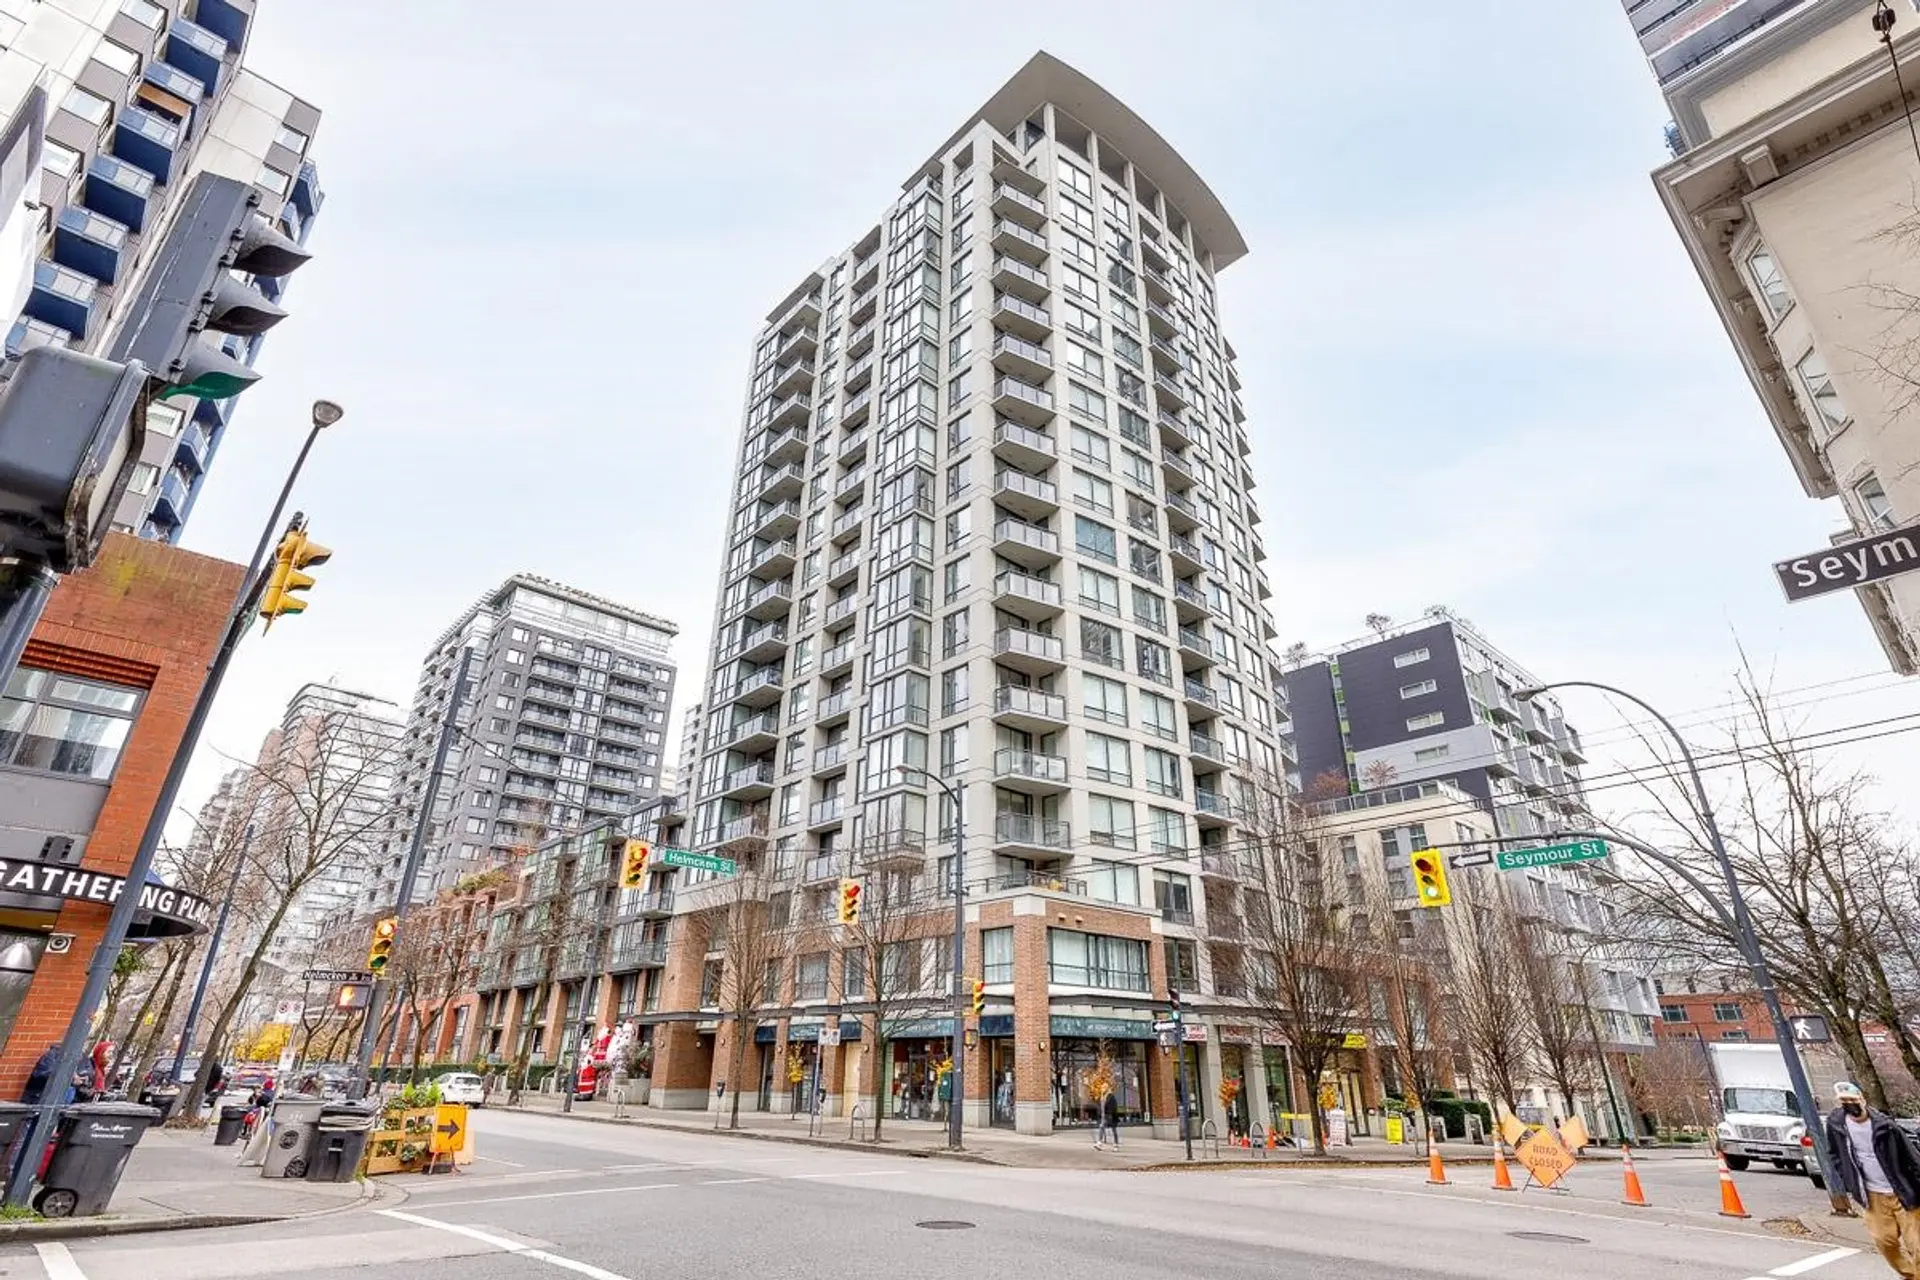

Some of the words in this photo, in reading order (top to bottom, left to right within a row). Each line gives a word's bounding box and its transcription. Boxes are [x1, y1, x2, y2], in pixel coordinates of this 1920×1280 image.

[668, 852, 718, 870] Helmcken
[720, 860, 732, 873] St
[1503, 847, 1575, 866] Seymour
[1579, 843, 1600, 856] St
[0, 861, 175, 914] ATHENG
[1532, 1143, 1559, 1157] ROAD
[1528, 1156, 1563, 1170] CLOSED
